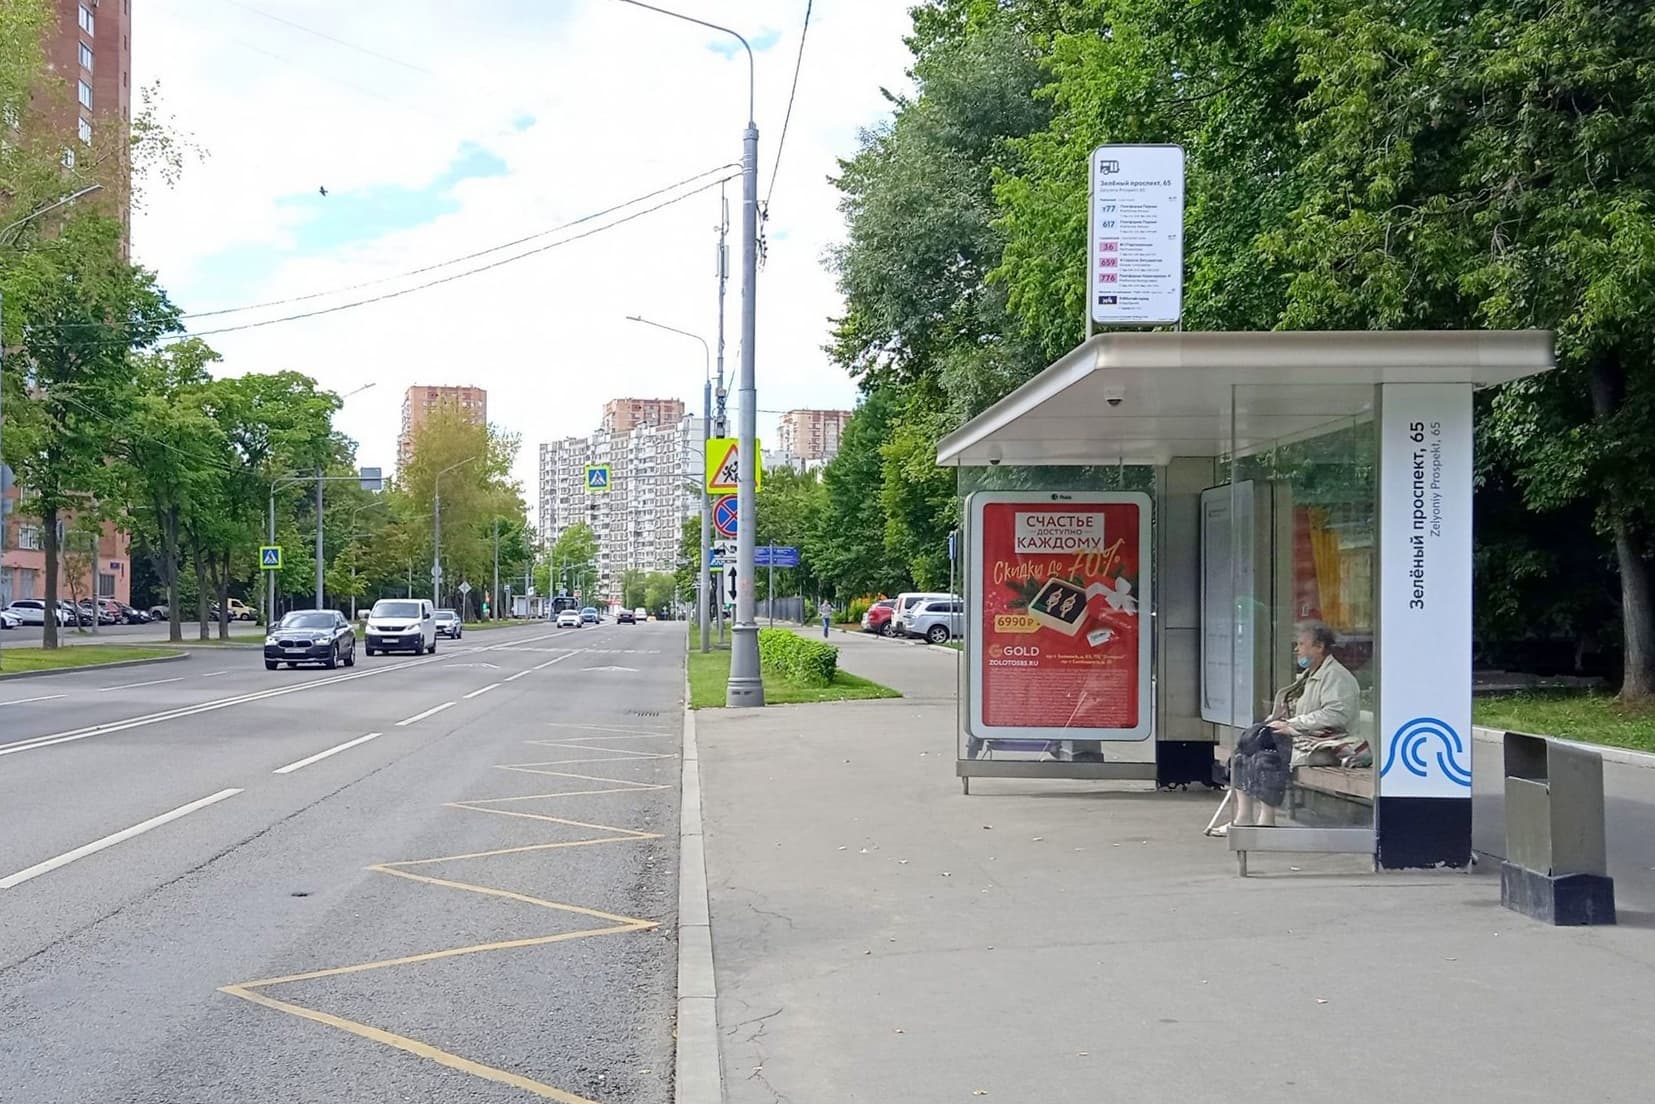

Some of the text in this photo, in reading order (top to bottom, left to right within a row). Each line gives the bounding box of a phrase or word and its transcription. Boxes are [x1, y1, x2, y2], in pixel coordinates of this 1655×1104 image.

[1102, 220, 1116, 228] 617
[1101, 258, 1116, 267] 659
[1101, 274, 1116, 282] 776
[1430, 421, 1443, 537] Zelyoniy Prospekt, 65
[1026, 515, 1094, 527] СЧАСТЬЕ
[1409, 421, 1428, 610] Зелёный проспект, 65
[1036, 528, 1083, 536] ДОСТУПНО
[1017, 536, 1102, 550] КАЖДОМУ
[993, 560, 1044, 585] Скидки
[1067, 538, 1125, 582] 70%
[1003, 646, 1040, 657] GOLD
